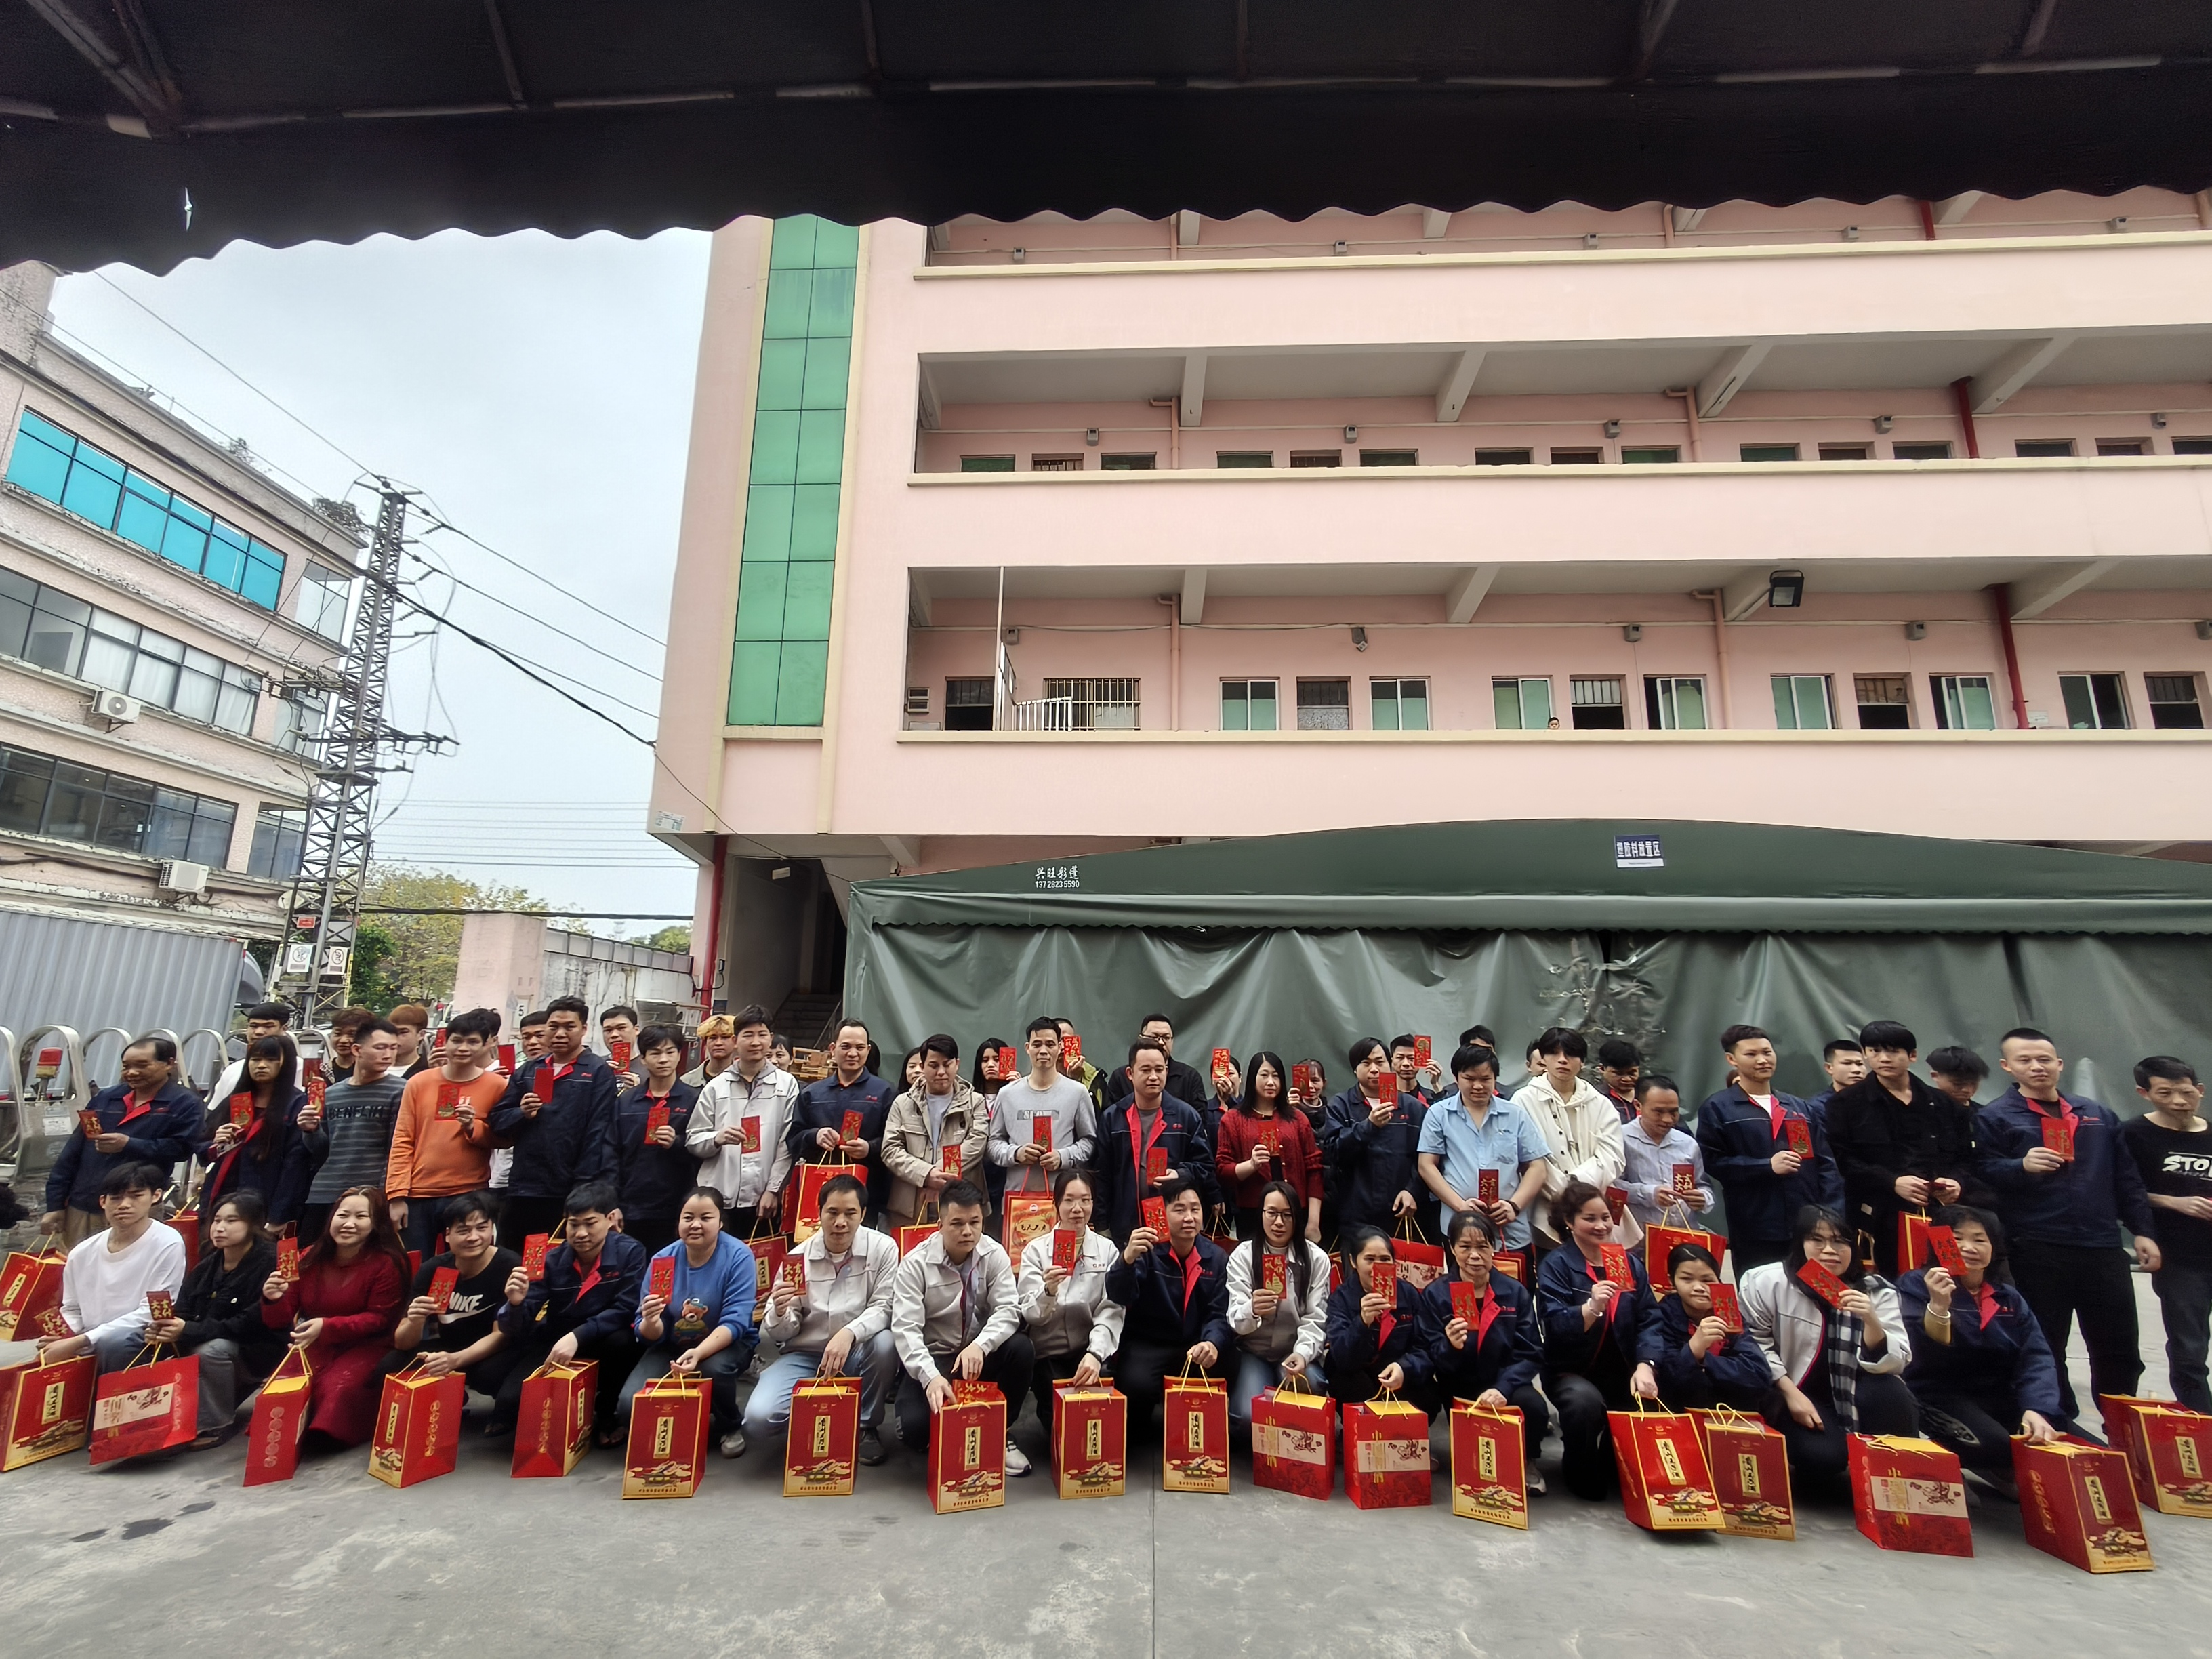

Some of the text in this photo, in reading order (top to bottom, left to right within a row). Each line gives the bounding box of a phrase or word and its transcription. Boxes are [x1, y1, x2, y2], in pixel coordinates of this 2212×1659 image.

[518, 1005, 524, 1017] 5
[2162, 1155, 2212, 1177] STO
[449, 1292, 483, 1313] NIKE
